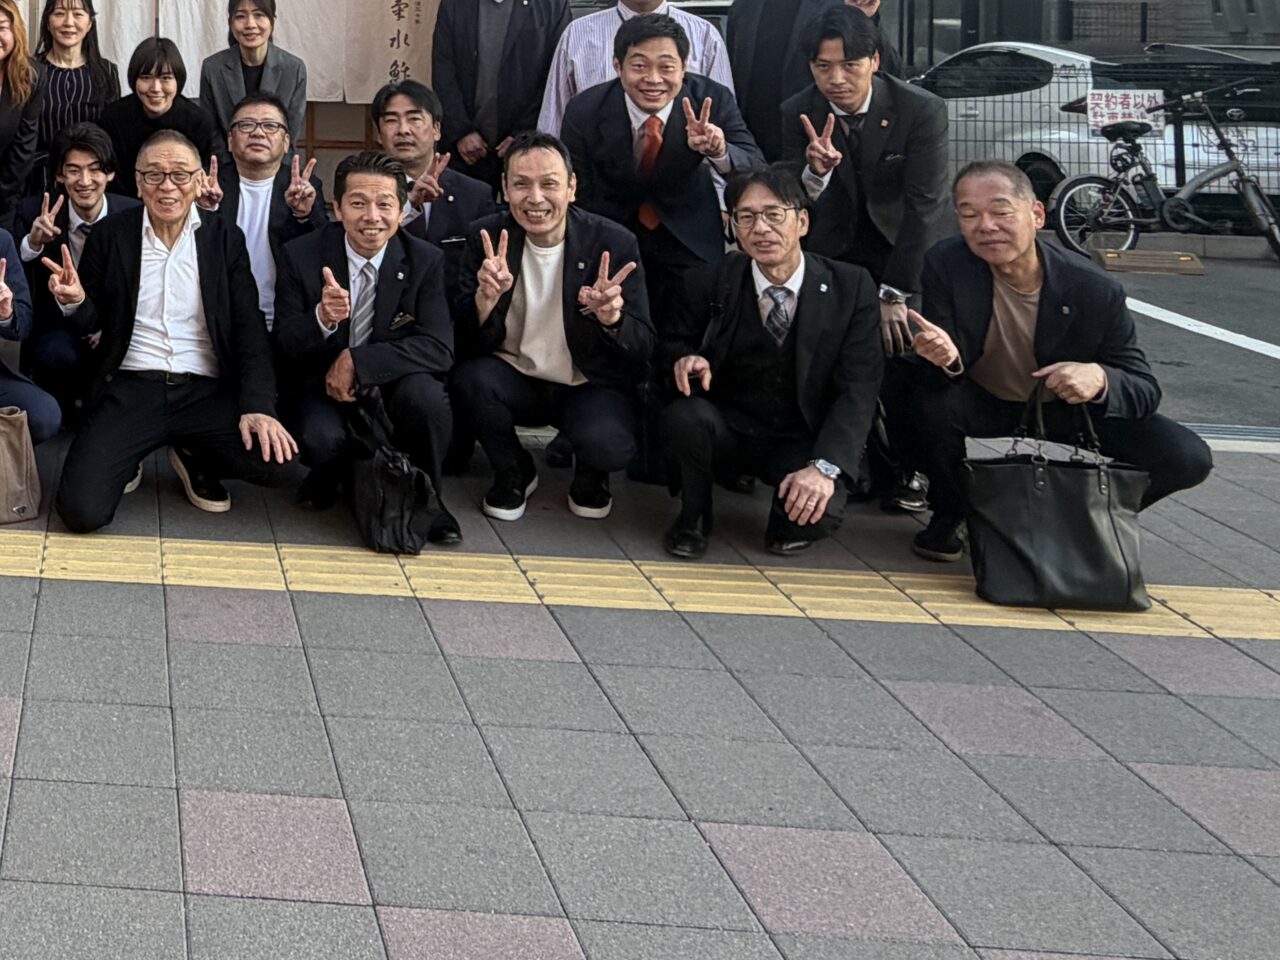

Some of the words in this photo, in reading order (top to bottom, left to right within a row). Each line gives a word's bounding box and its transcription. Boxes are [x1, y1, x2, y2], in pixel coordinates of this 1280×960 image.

[1090, 92, 1159, 110] 契約者以外
